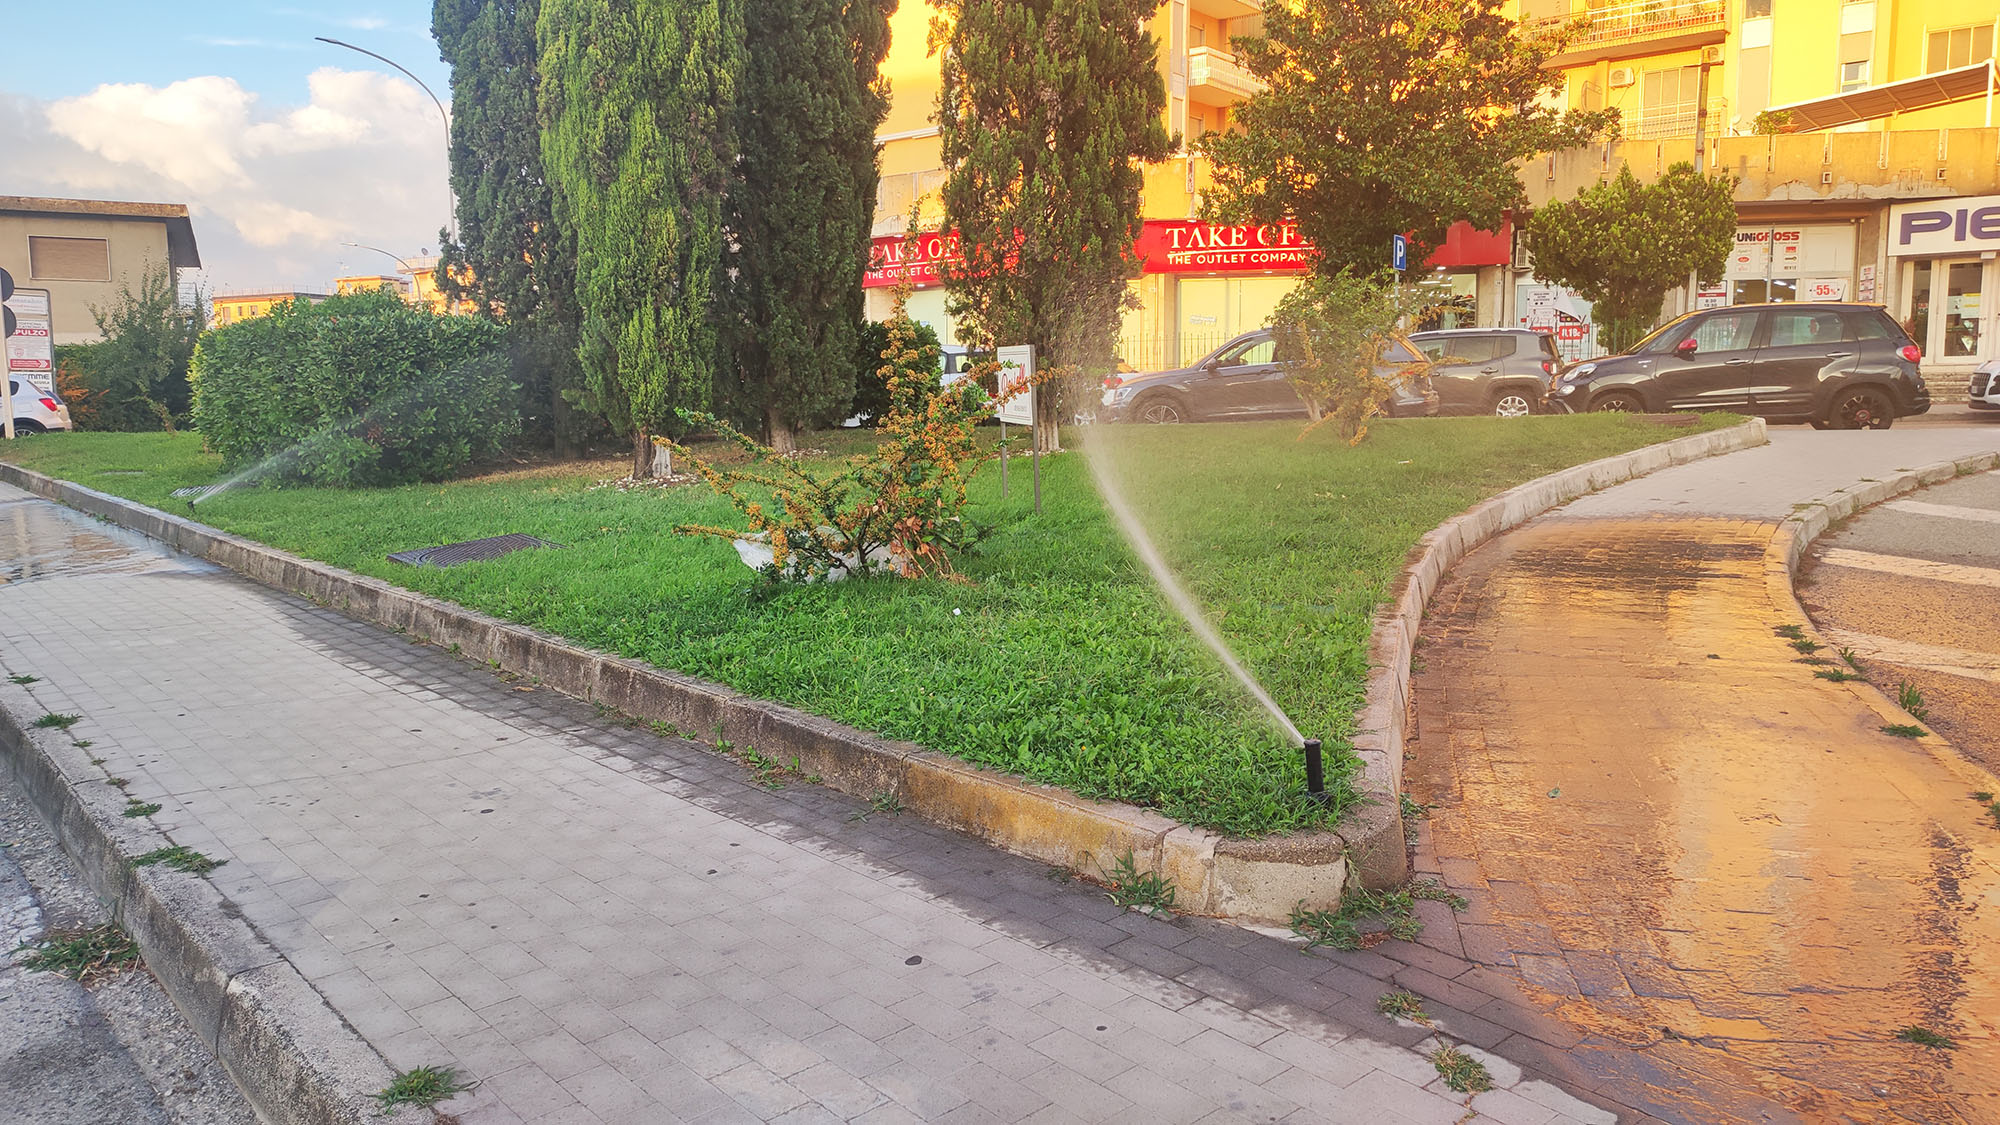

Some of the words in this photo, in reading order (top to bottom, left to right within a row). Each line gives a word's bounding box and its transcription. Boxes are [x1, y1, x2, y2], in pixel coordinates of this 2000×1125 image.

[1165, 225, 1248, 249] TAKE
[1257, 224, 1309, 246] OF
[869, 240, 923, 265] TAKE
[1168, 254, 1191, 265] THE
[1196, 253, 1246, 265] OUTLET
[1250, 252, 1306, 263] COMPAN
[1396, 240, 1404, 265] P
[867, 271, 884, 280] THE
